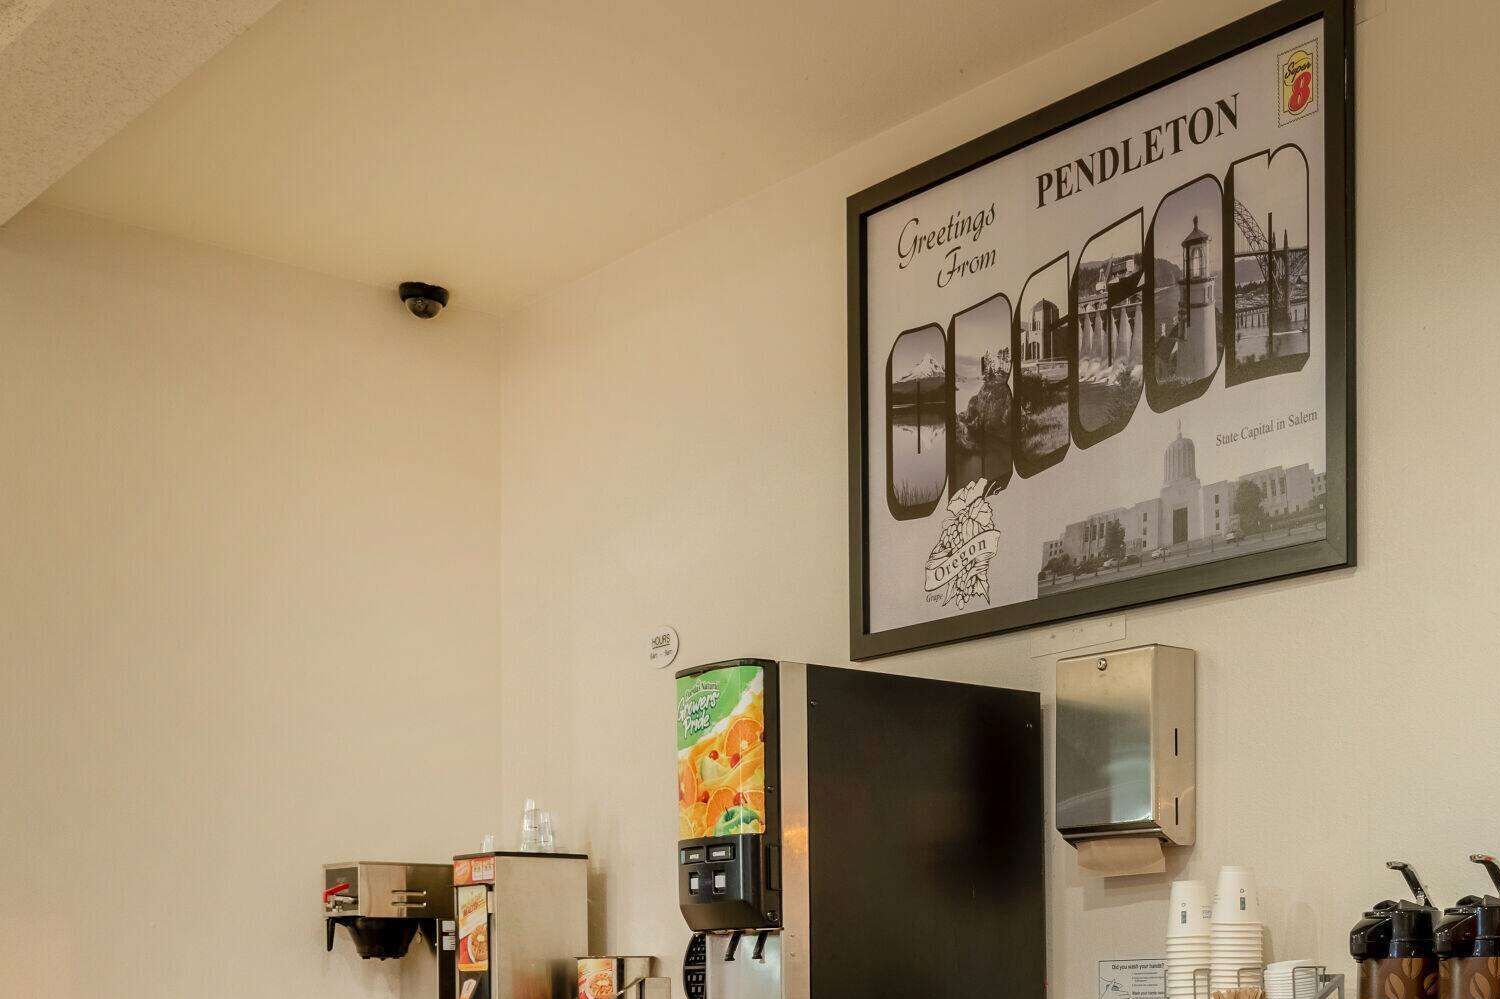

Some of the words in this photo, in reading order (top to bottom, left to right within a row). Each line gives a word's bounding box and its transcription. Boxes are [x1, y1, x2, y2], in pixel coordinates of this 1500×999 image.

[1288, 71, 1312, 112] 8
[1035, 92, 1240, 209] PENDLETON
[897, 202, 997, 270] Greetings
[937, 246, 997, 288] From
[1215, 432, 1240, 447] State
[1240, 420, 1275, 440] Capital
[1276, 418, 1286, 431] in
[1288, 411, 1319, 428] Salem
[934, 540, 987, 582] Oregon
